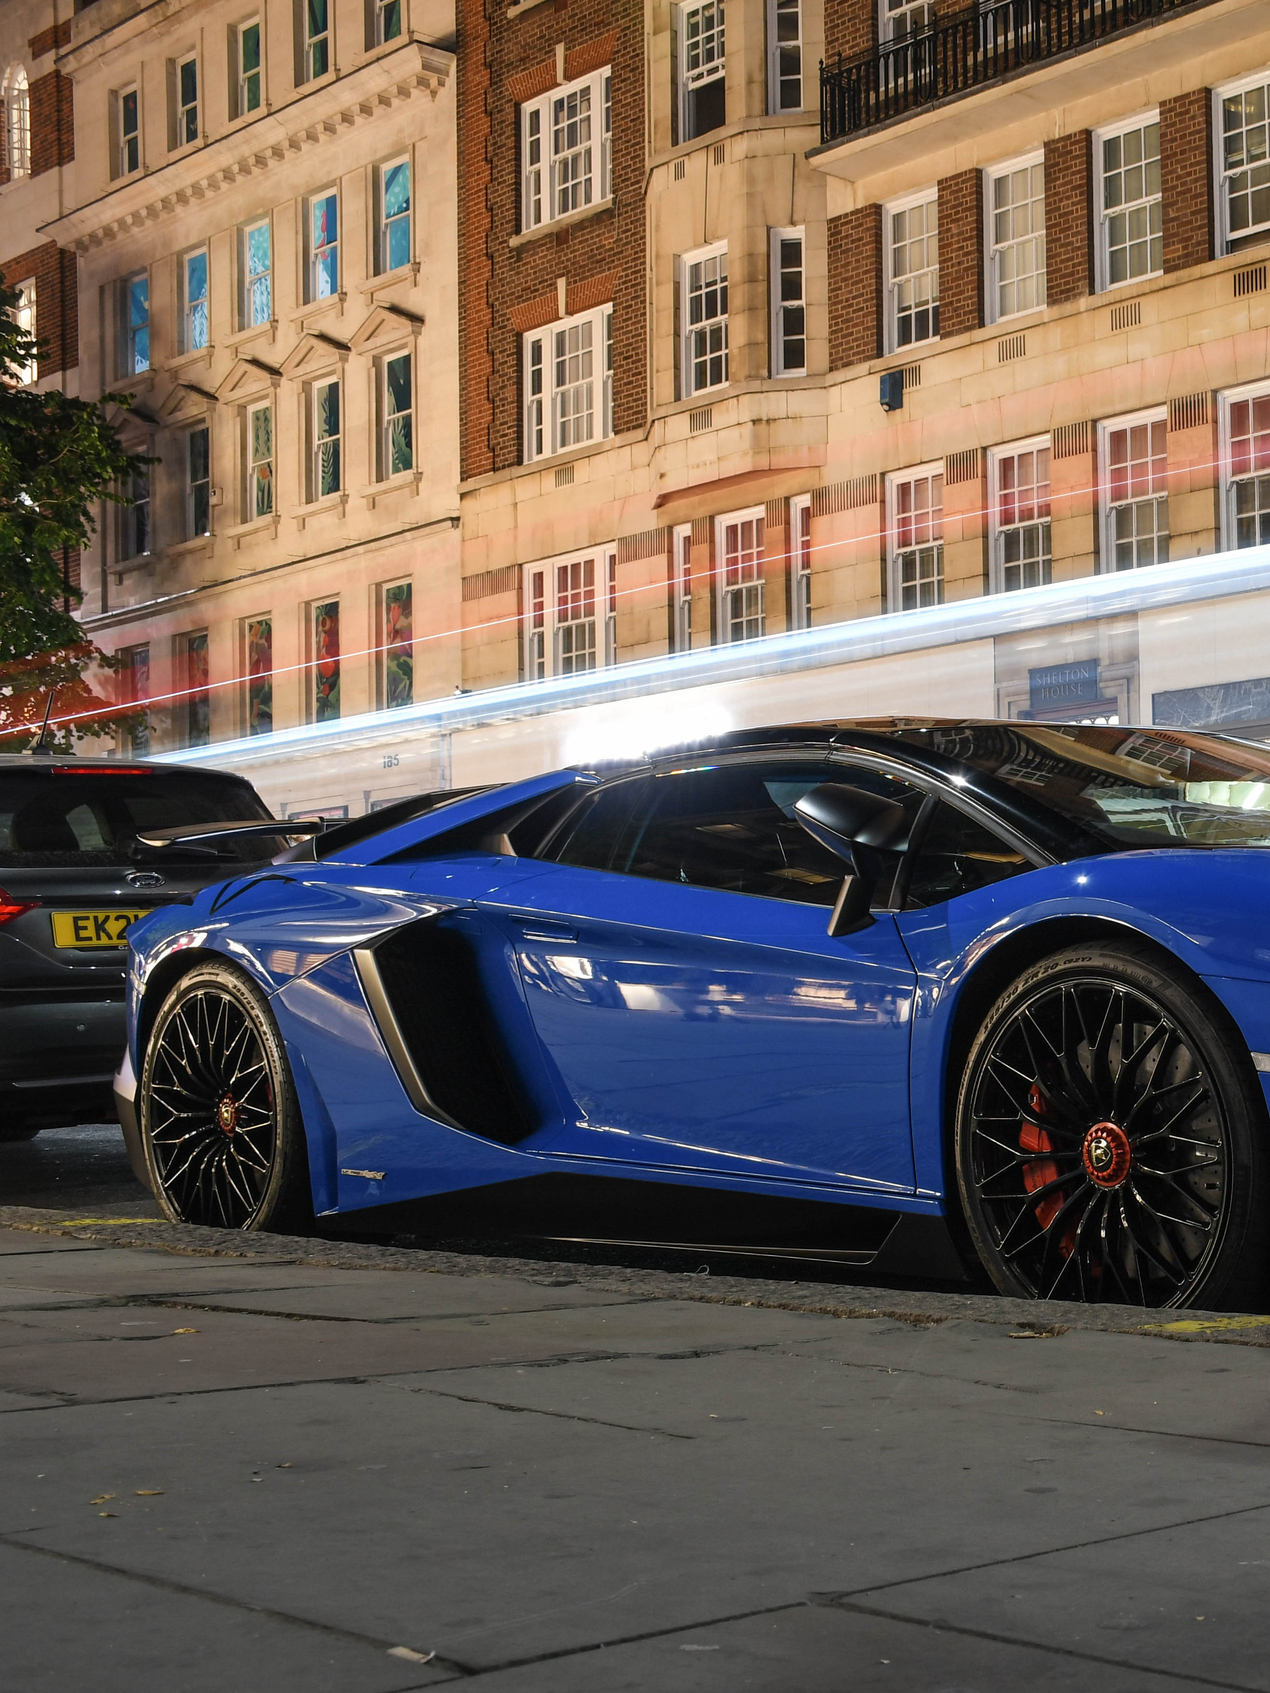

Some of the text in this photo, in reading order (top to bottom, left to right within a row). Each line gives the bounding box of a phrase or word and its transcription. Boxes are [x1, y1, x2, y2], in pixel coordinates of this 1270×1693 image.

[1036, 667, 1089, 686] SHELTON
[1041, 682, 1084, 700] HOUSE
[383, 754, 400, 769] 185
[73, 914, 142, 942] EK2
[1022, 970, 1041, 987] ZR
[1041, 962, 1059, 975] 20
